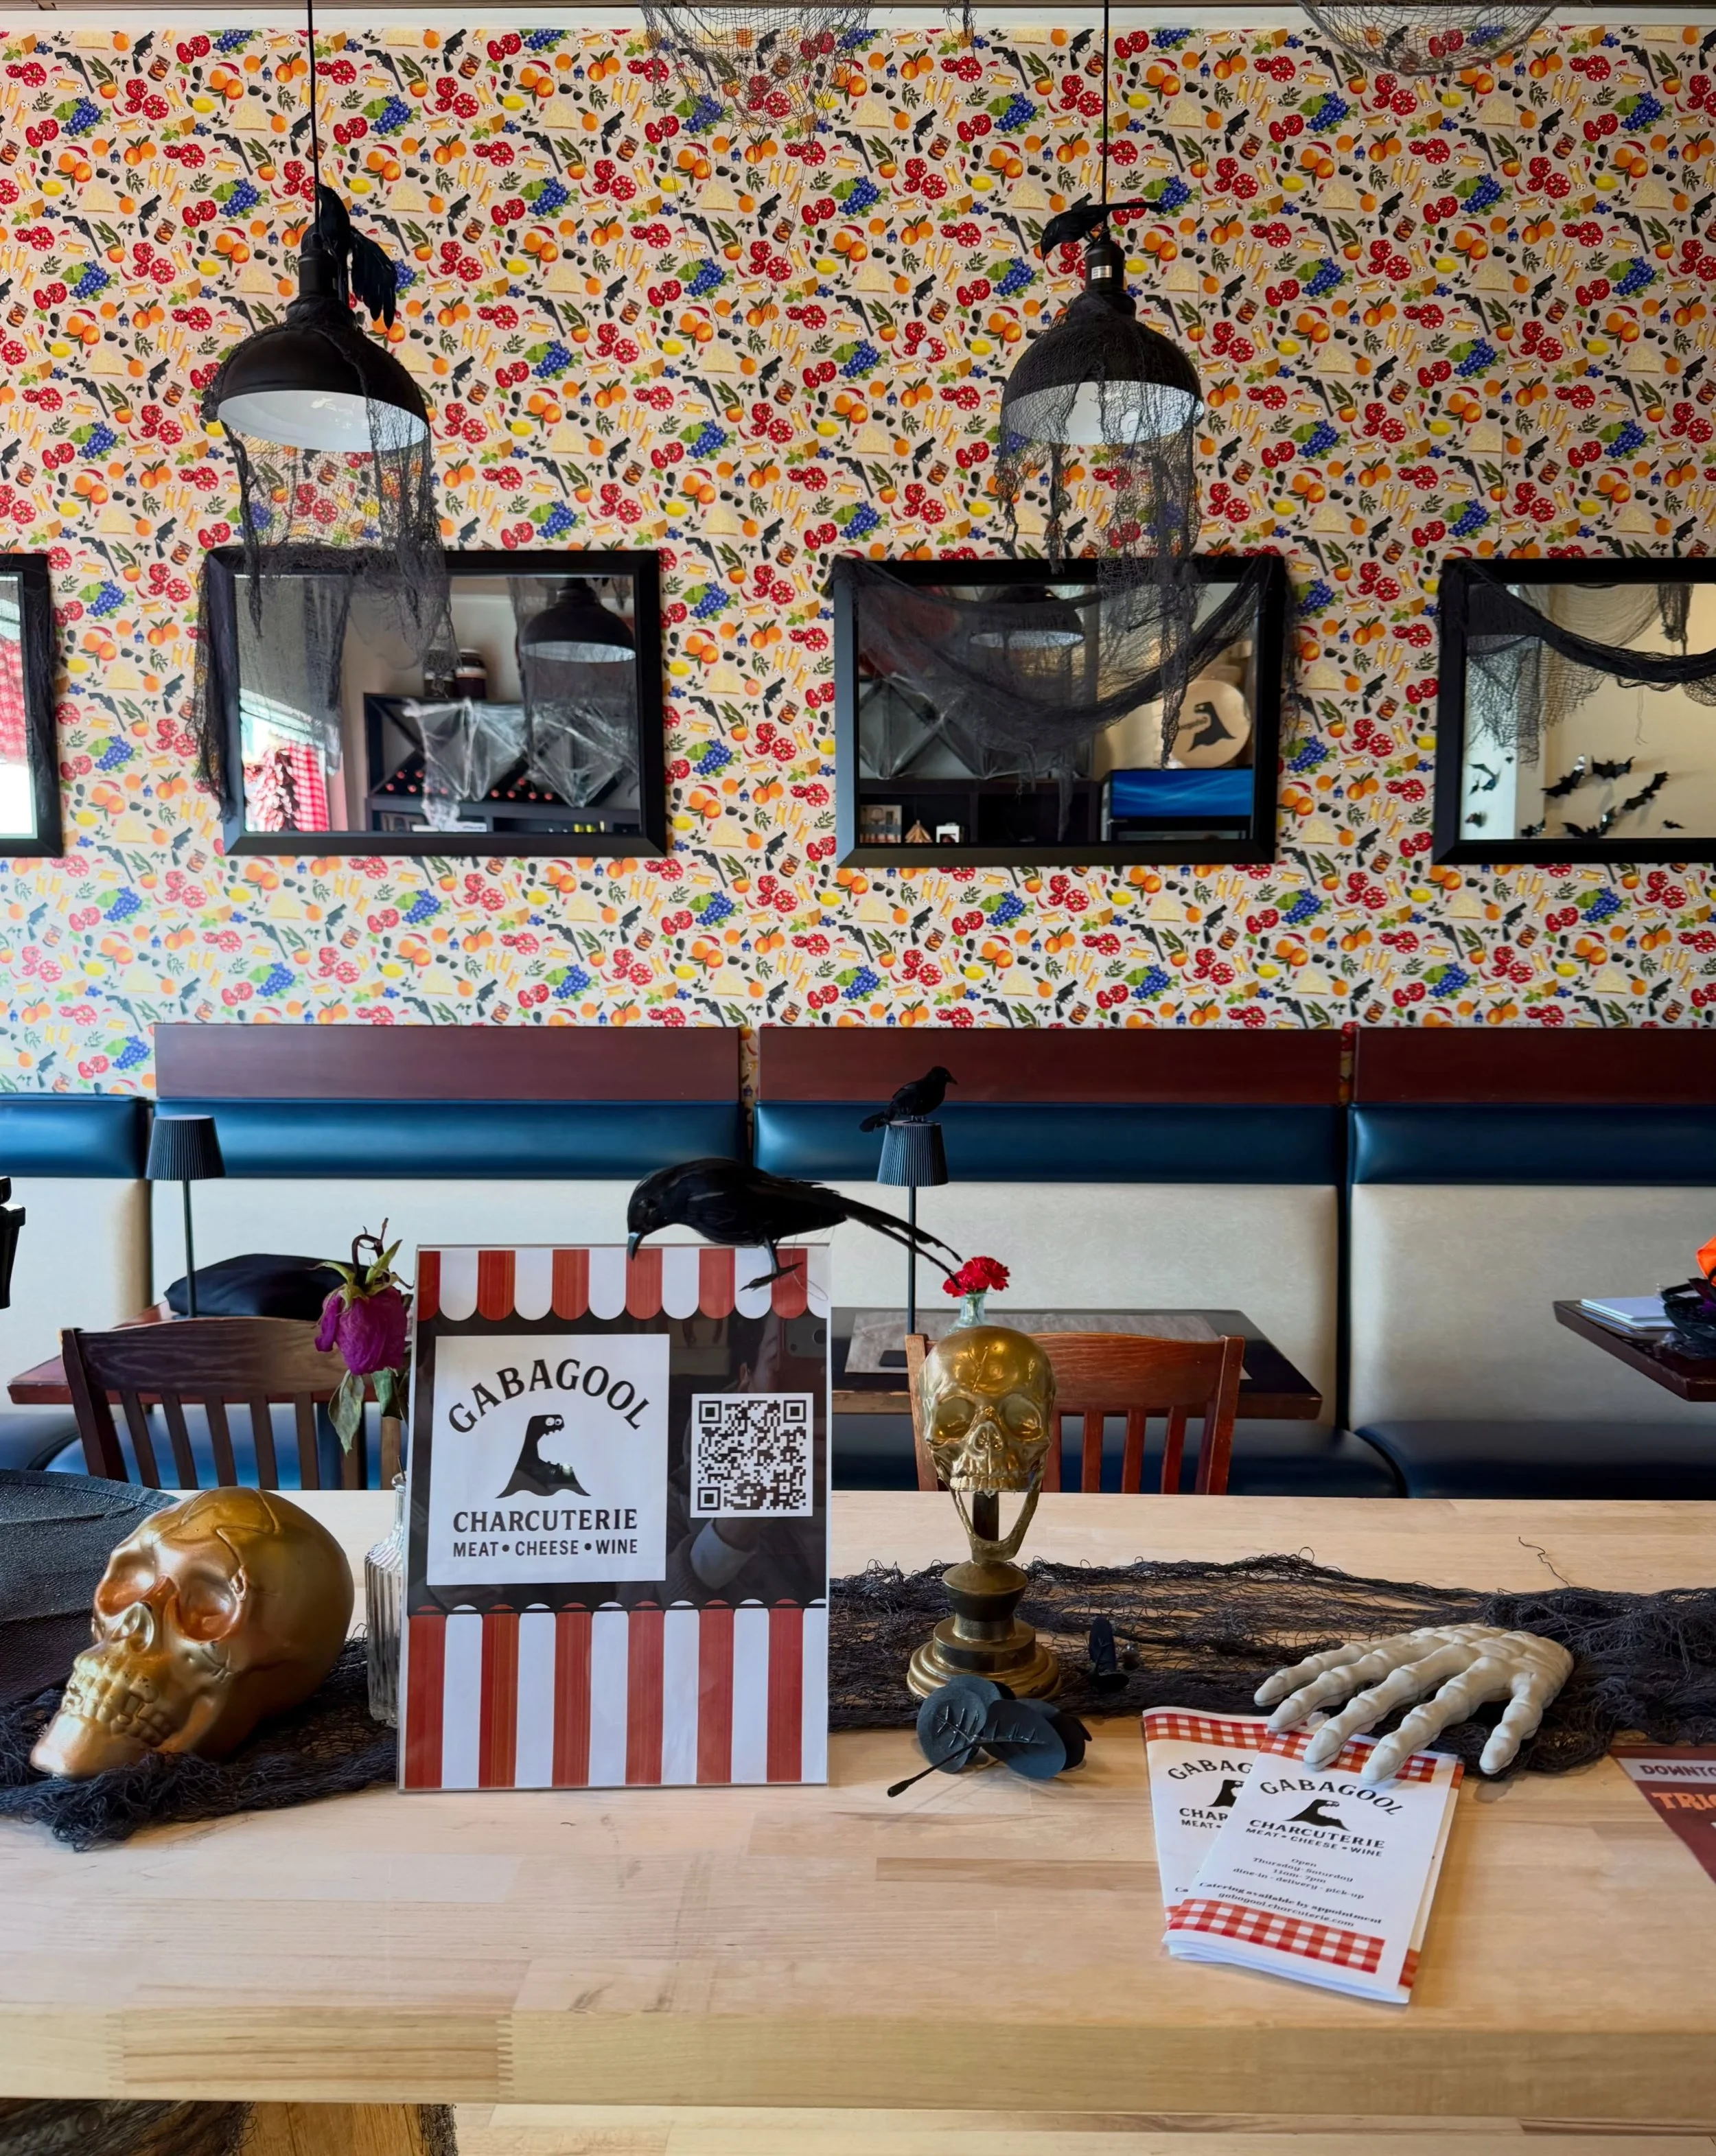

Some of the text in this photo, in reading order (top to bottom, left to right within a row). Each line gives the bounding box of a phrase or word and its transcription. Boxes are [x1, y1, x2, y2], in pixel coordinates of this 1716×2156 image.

[448, 1358, 650, 1434] GABAGOOL
[452, 1508, 638, 1533] CHARCUTERIE
[453, 1538, 638, 1557] MEAT CHEESE WINE
[1260, 1778, 1403, 1816] GABAGOOL
[1181, 1819, 1214, 1829] MEAT
[1249, 1819, 1385, 1849] CHARCUTERIE
[1246, 1827, 1383, 1857] MEAT CHEESE WINE
[1291, 1858, 1317, 1867] Open
[1306, 1868, 1354, 1882] Saturday
[1233, 1868, 1365, 1900] dine-in delivery pick-up
[1199, 1882, 1382, 1924] Catering available by appointment
